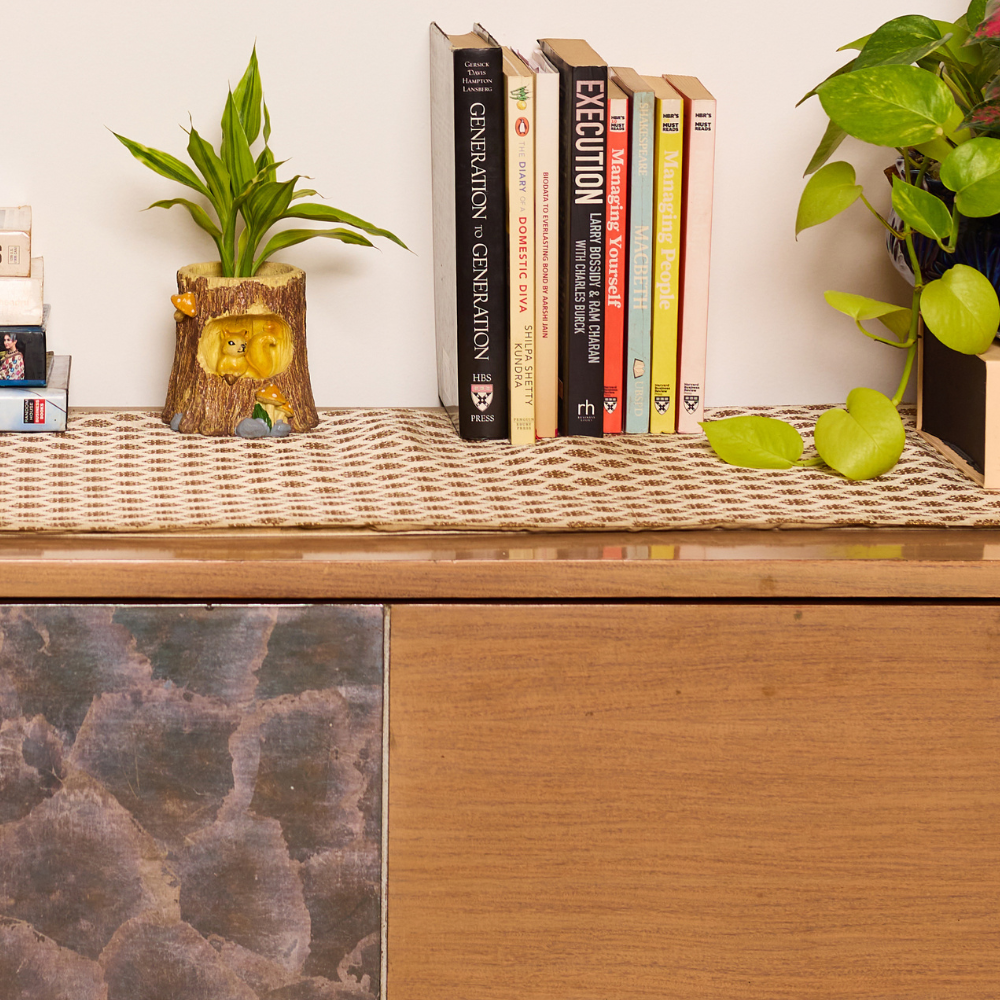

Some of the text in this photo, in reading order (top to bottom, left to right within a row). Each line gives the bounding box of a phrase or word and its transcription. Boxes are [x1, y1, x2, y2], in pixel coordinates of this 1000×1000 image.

[574, 80, 605, 204] EXECUTION
[638, 102, 649, 176] SHAKESPEARE
[519, 161, 527, 193] DIARY
[520, 196, 526, 205] OF
[542, 204, 549, 213] TO
[470, 102, 490, 361] GENERATION TO GENERATION
[518, 216, 528, 279] DOMESTIC
[606, 148, 625, 309] Managing Yourself
[655, 150, 679, 310] Managing People
[519, 284, 528, 313] DIVA
[542, 286, 549, 295] BY
[574, 240, 586, 334] WITH CHARLES BURCK
[588, 213, 602, 364] LARRY BOSSIDY & RAM CHARAN
[633, 225, 650, 310] MACBETH
[472, 373, 492, 382] HBS
[514, 343, 523, 389] KUNDRA
[524, 325, 533, 406] SHILPA SHETTY
[577, 399, 595, 416] rh
[634, 381, 644, 417] UBSPD
